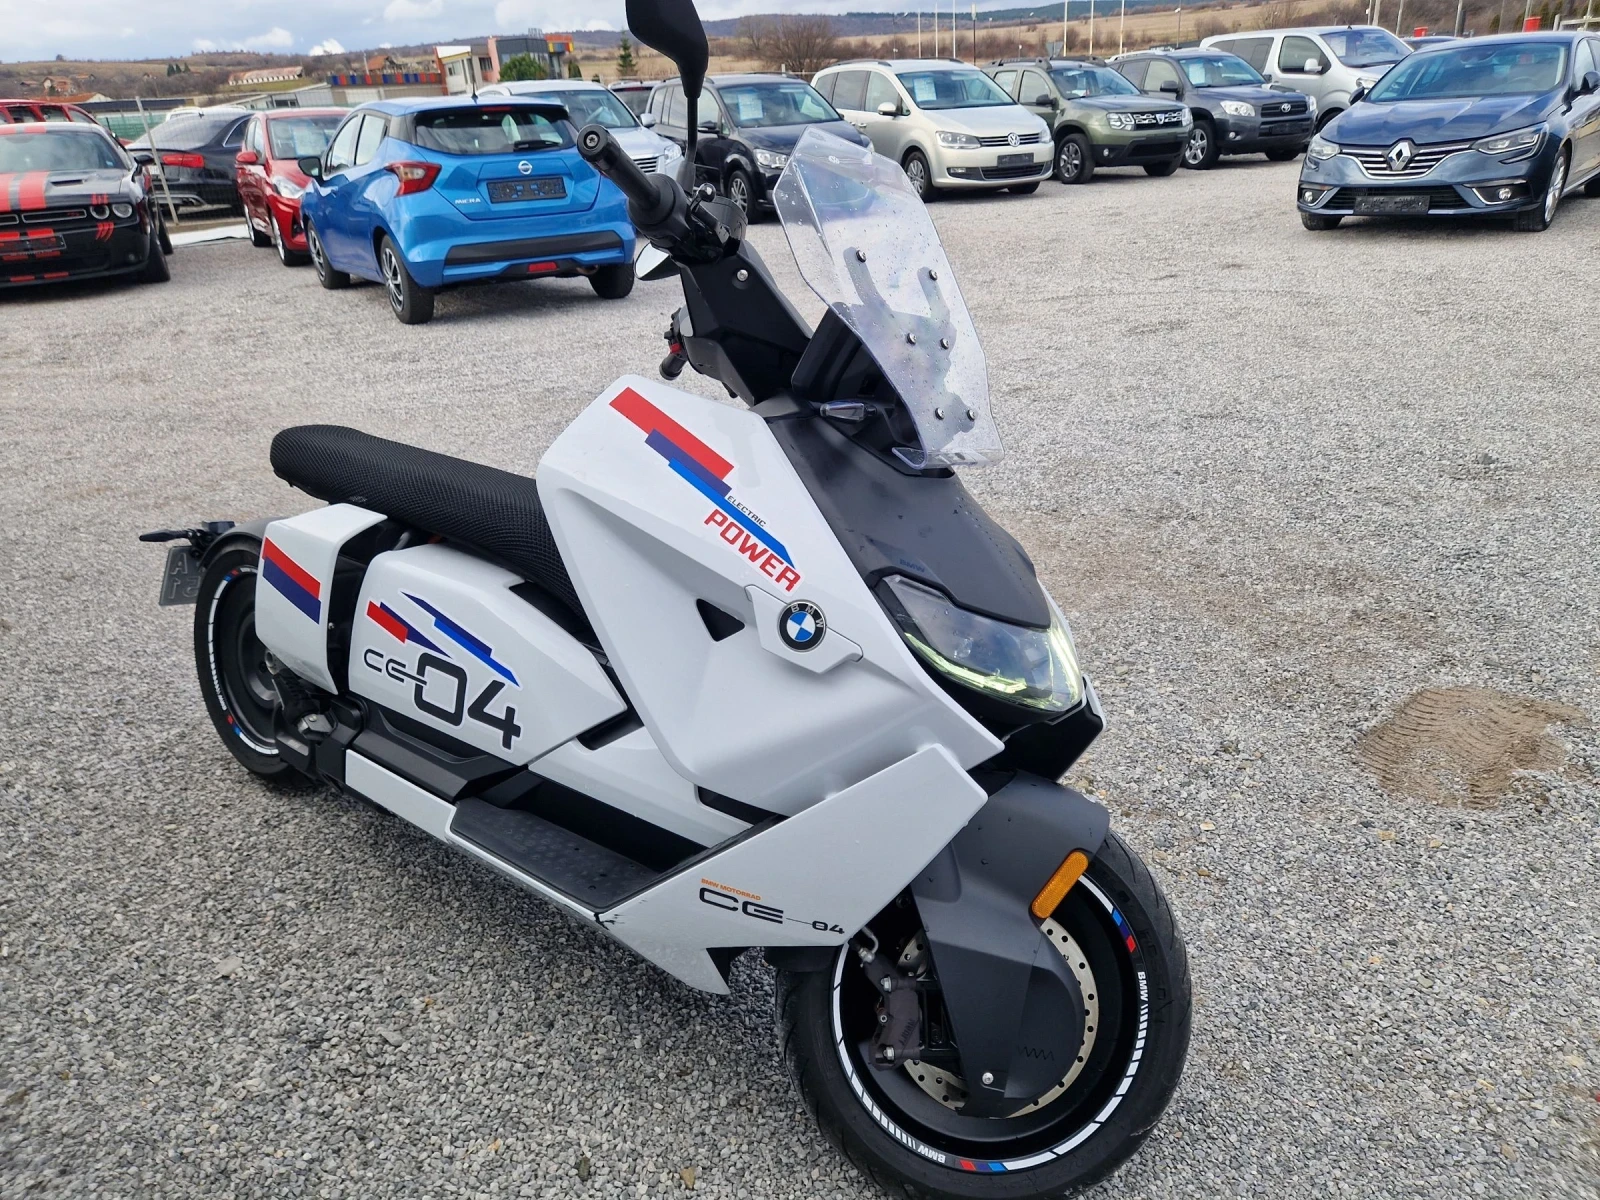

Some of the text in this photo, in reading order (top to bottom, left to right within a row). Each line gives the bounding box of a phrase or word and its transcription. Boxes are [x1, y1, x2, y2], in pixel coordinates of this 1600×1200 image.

[727, 495, 767, 527] ELECTRIC
[703, 508, 802, 592] POWER
[701, 878, 761, 901] BMW MOTORRAD
[1137, 971, 1149, 1002] BMW
[917, 1144, 947, 1164] BMW
